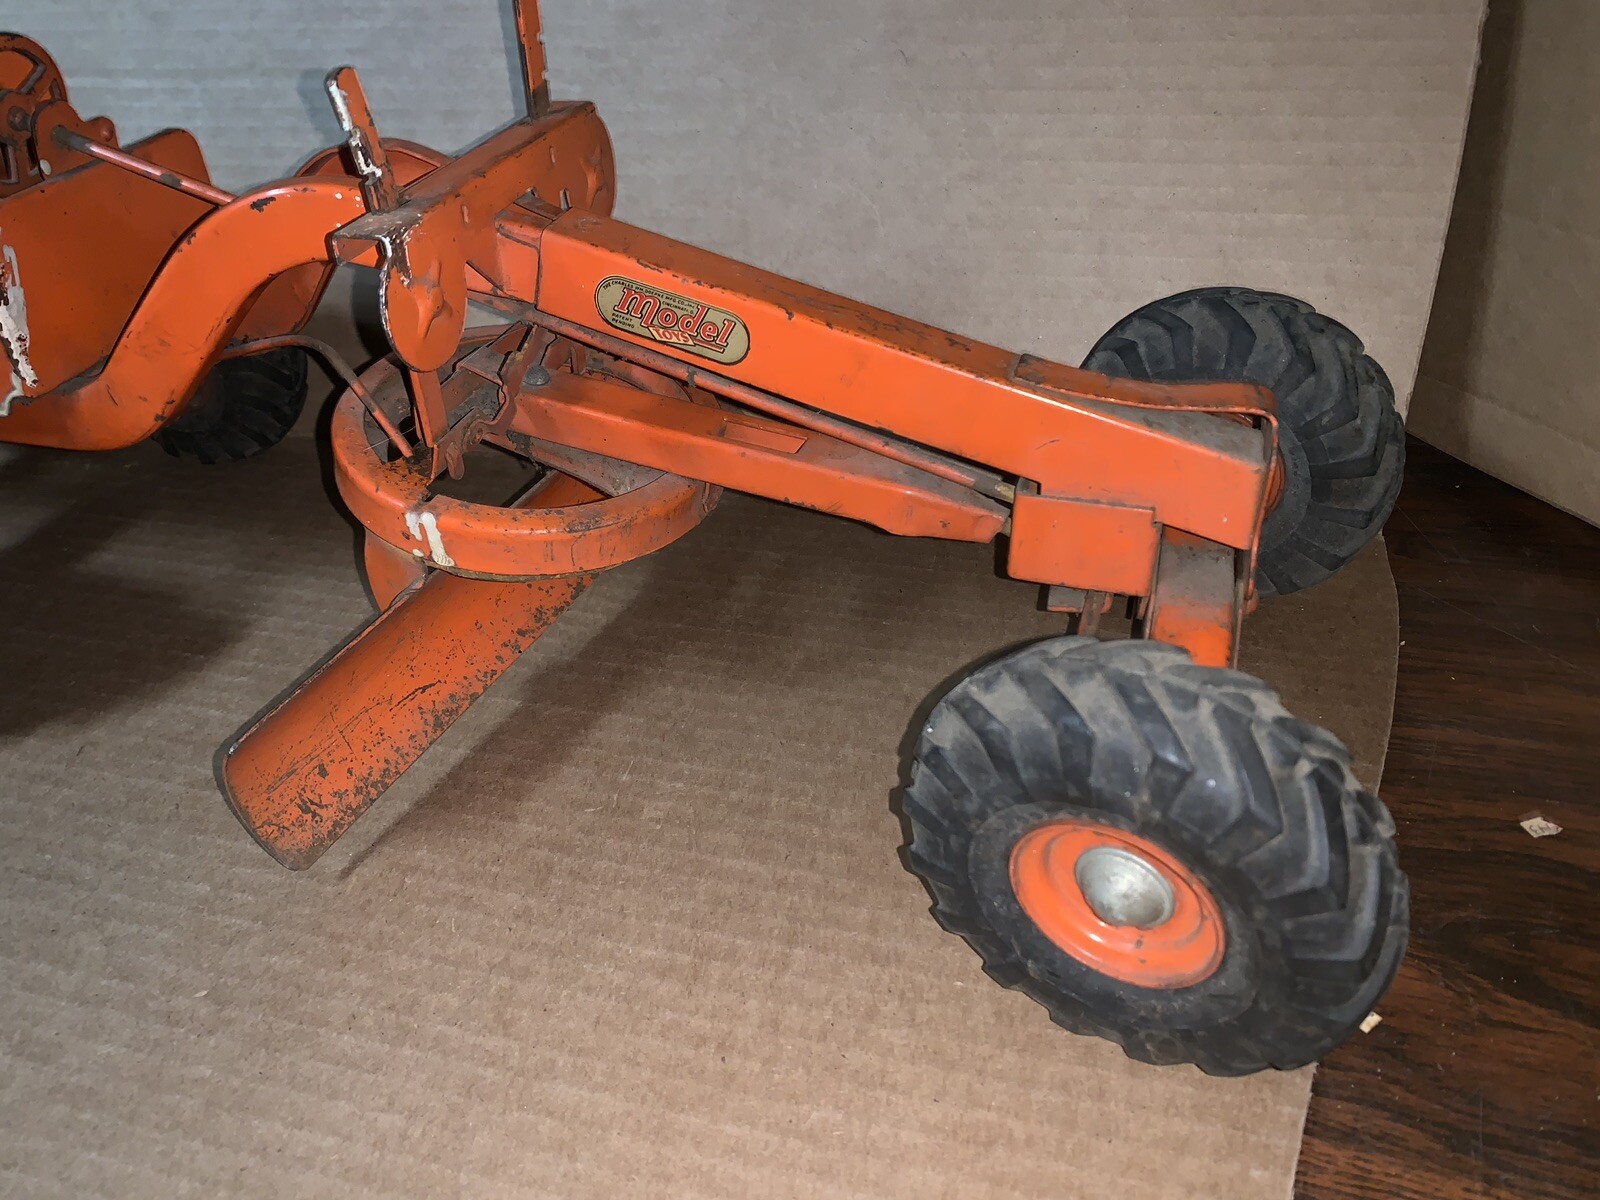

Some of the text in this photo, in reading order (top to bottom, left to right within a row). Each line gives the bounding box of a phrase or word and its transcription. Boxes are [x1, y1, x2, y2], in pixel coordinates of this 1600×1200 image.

[603, 281, 612, 290] THE
[611, 280, 634, 289] CHARLES
[611, 312, 633, 323] PATENT
[611, 317, 635, 329] PENDING
[653, 326, 690, 343] TOYS
